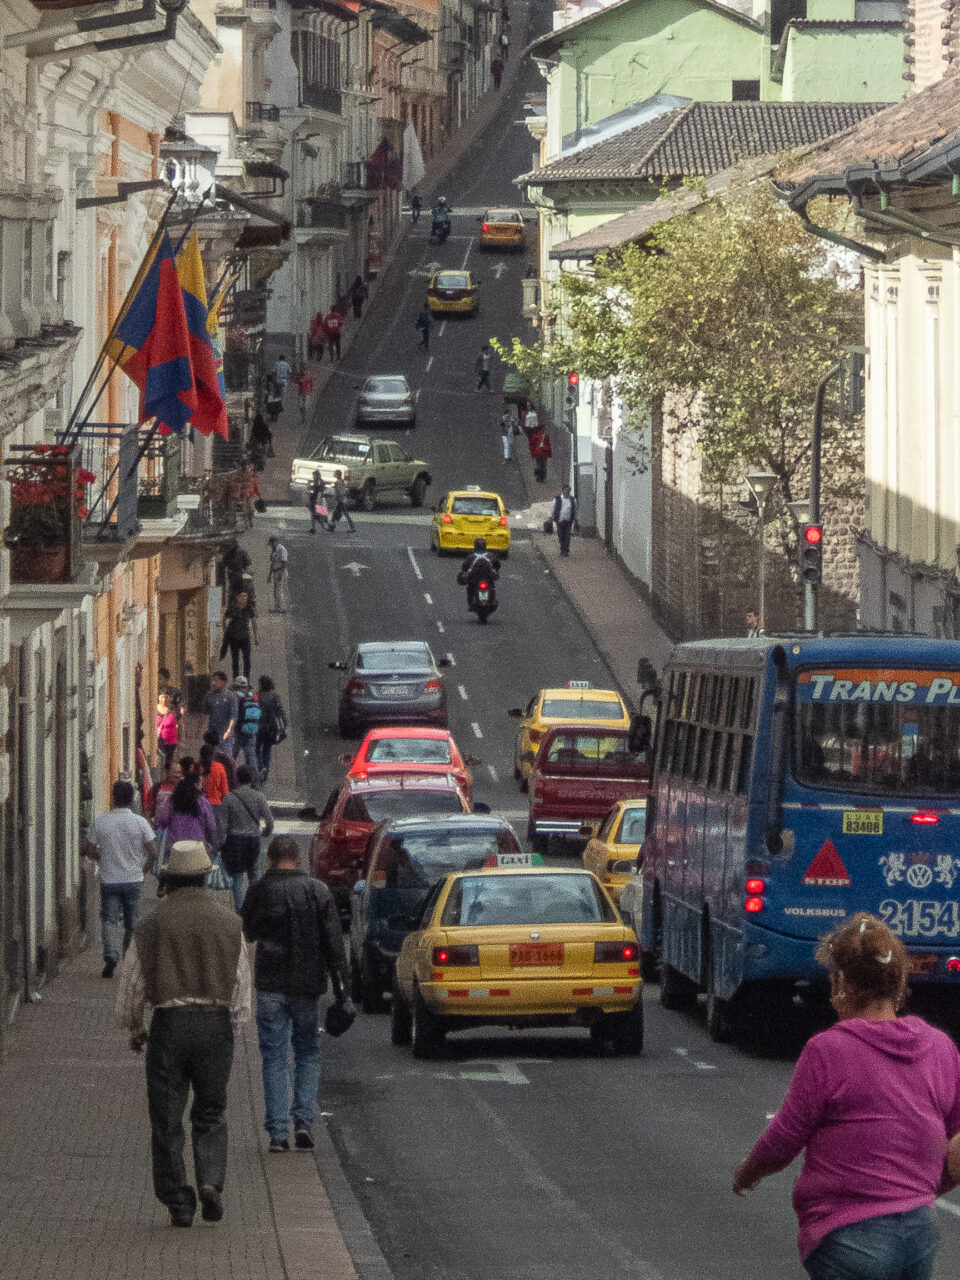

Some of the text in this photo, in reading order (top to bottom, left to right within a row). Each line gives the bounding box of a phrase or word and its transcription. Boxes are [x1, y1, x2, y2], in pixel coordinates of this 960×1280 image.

[810, 674, 918, 702] TRANS
[803, 878, 851, 886] STOP
[784, 907, 847, 917] VOLKSBUS
[878, 899, 960, 937] 2154
